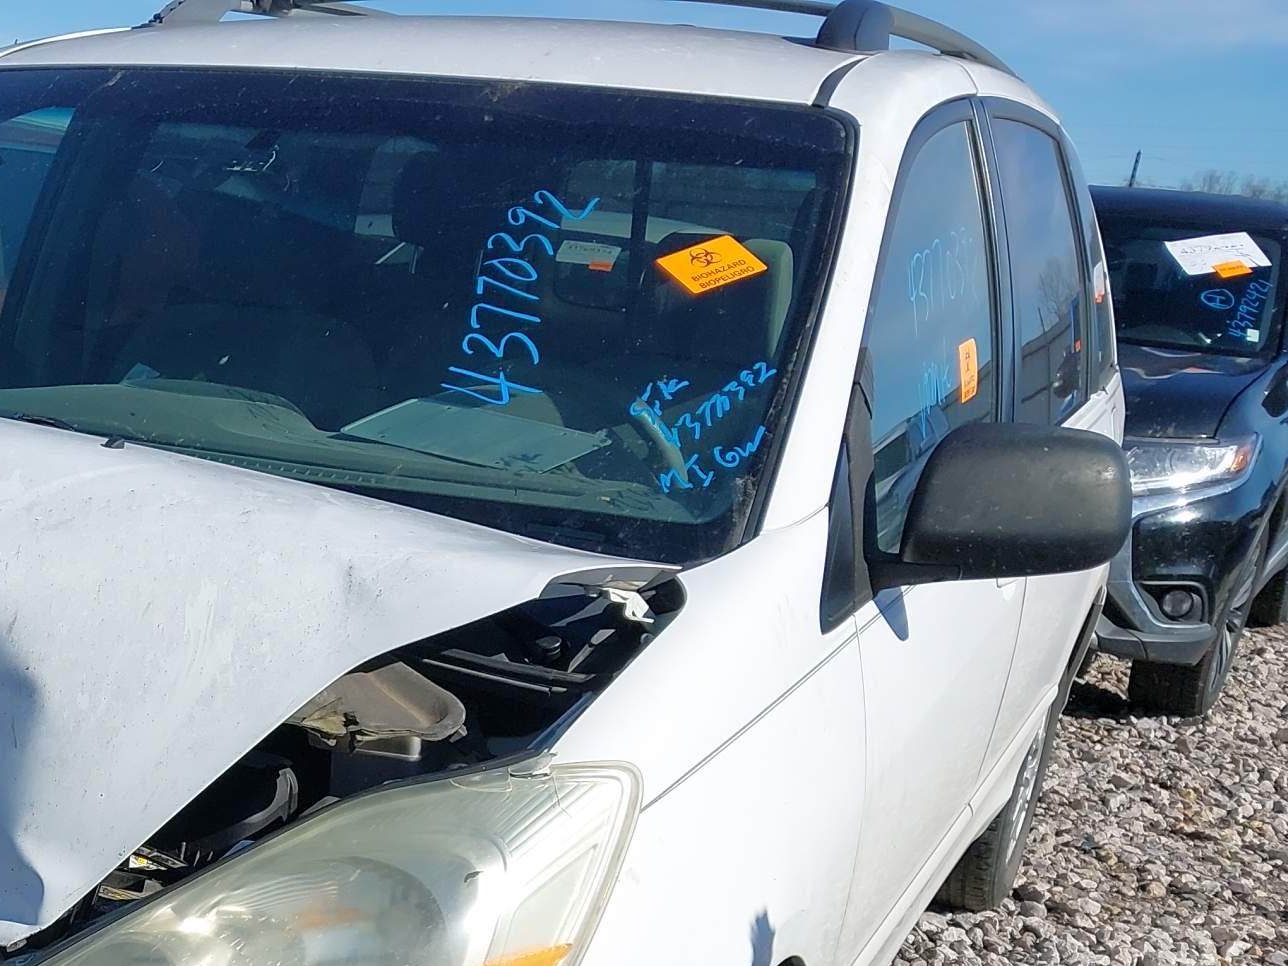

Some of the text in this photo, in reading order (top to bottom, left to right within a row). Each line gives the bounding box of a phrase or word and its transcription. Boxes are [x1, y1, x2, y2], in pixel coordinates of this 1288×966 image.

[690, 259, 747, 283] BIOHAZARD
[698, 265, 755, 289] BIOPELIGRO
[439, 189, 601, 405] 43770392
